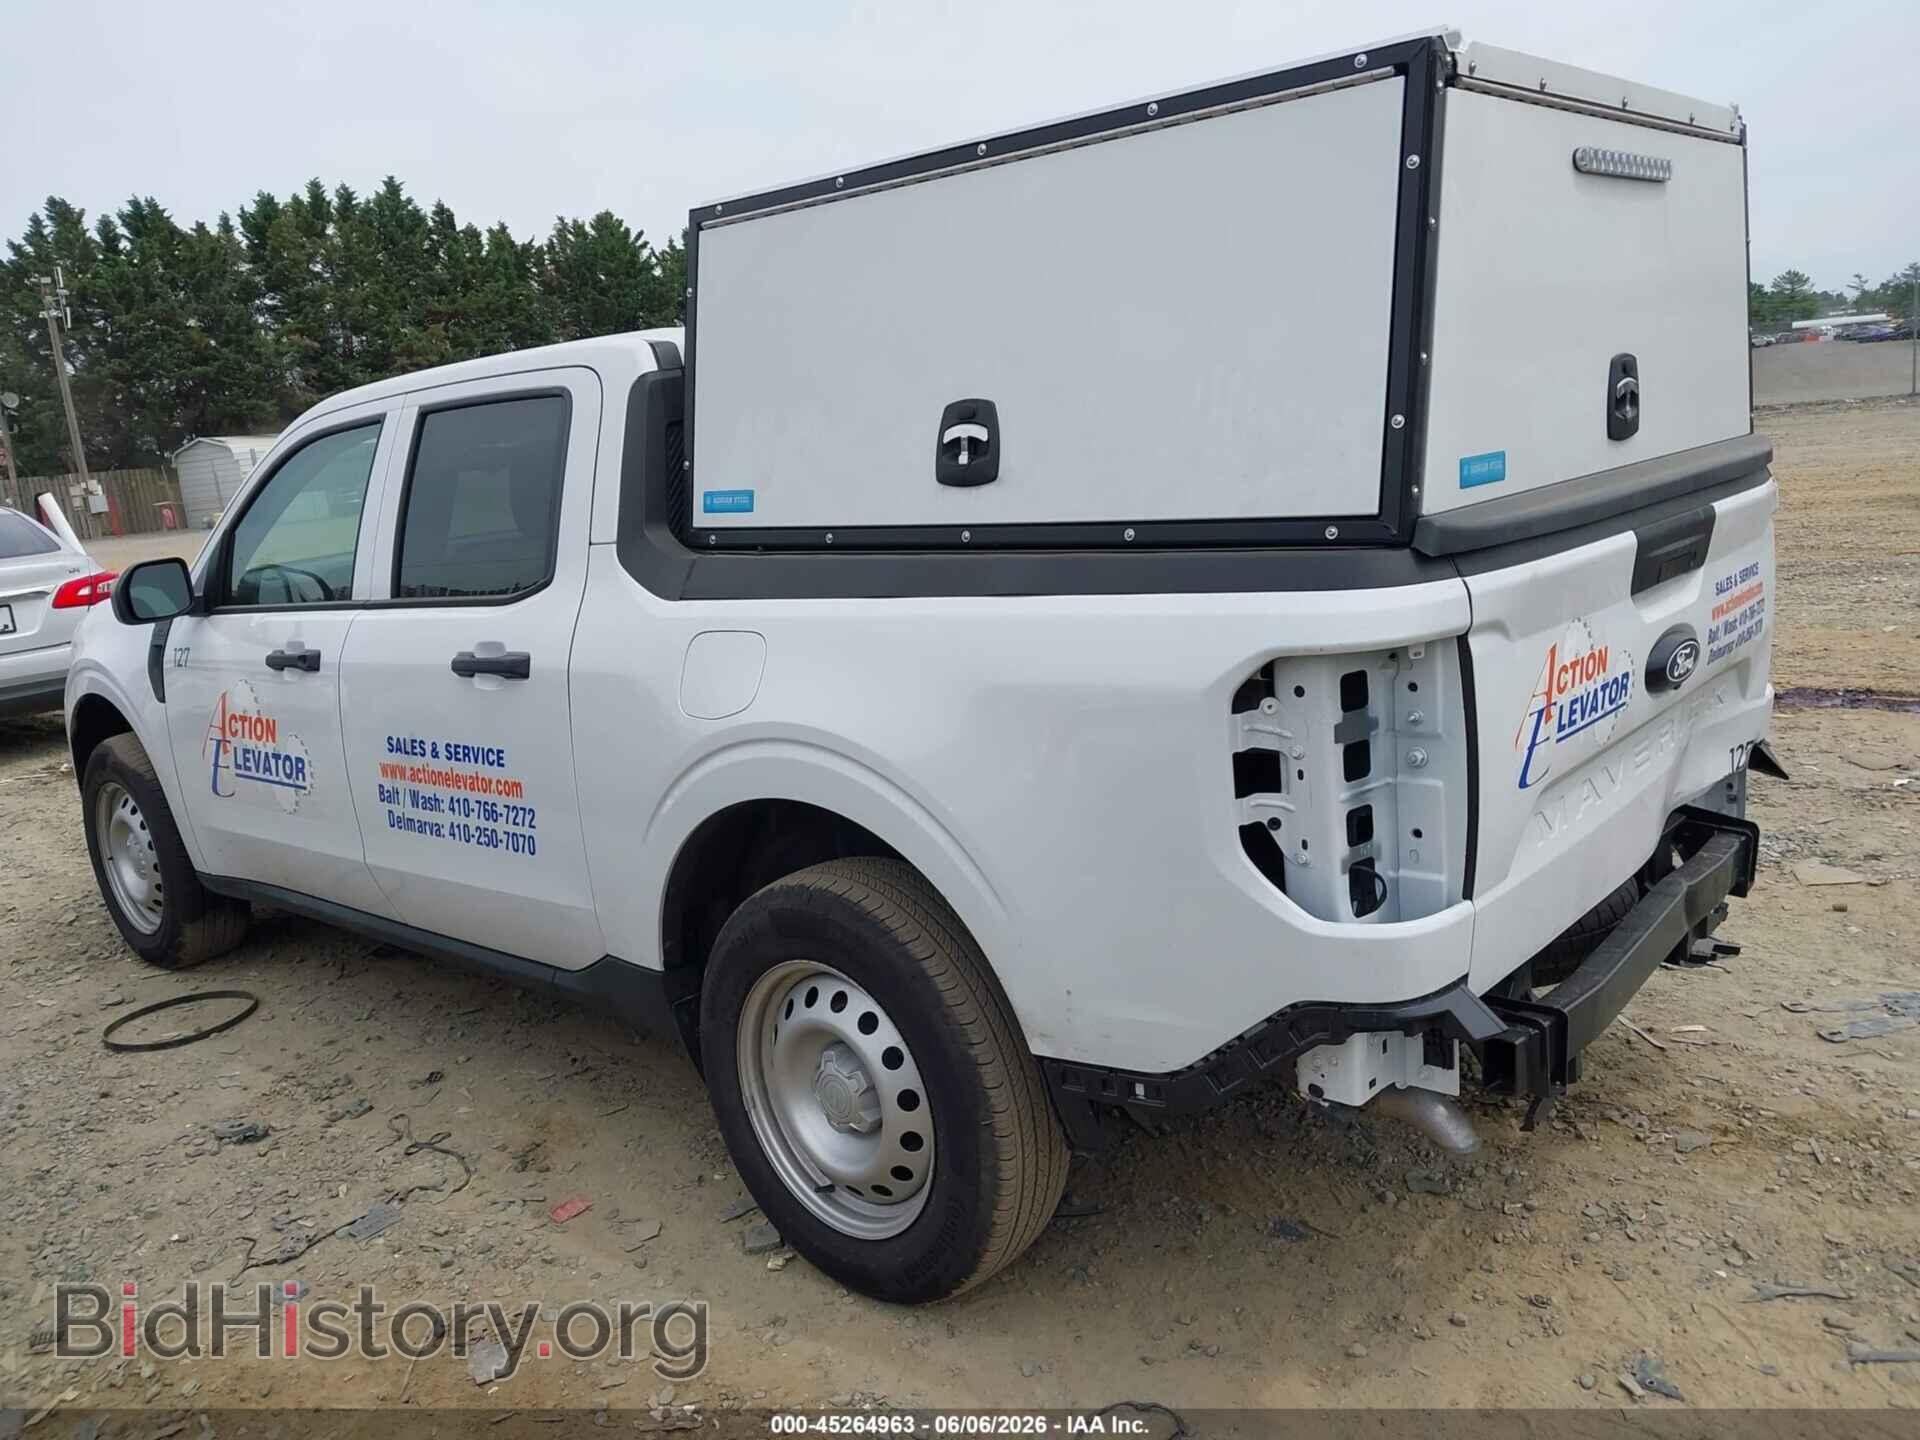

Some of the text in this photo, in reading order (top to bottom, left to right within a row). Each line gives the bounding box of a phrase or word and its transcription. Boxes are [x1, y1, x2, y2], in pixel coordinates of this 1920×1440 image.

[1715, 576, 1733, 596] SALES
[1739, 561, 1759, 584] SERVICE
[173, 648, 190, 668] 127
[1515, 643, 1608, 752] ACTION
[202, 690, 277, 760] ACTION
[1518, 671, 1630, 789] ELEVATOR
[209, 738, 306, 798] ELEVATOR
[387, 736, 505, 767] SALES & SERVICE
[379, 762, 523, 798] www.actionelevator.com
[378, 784, 400, 806] Balt
[409, 789, 445, 814] Wash:
[449, 796, 536, 829] 410-766-7272
[387, 810, 536, 856] Delmarva: 410-250-7070
